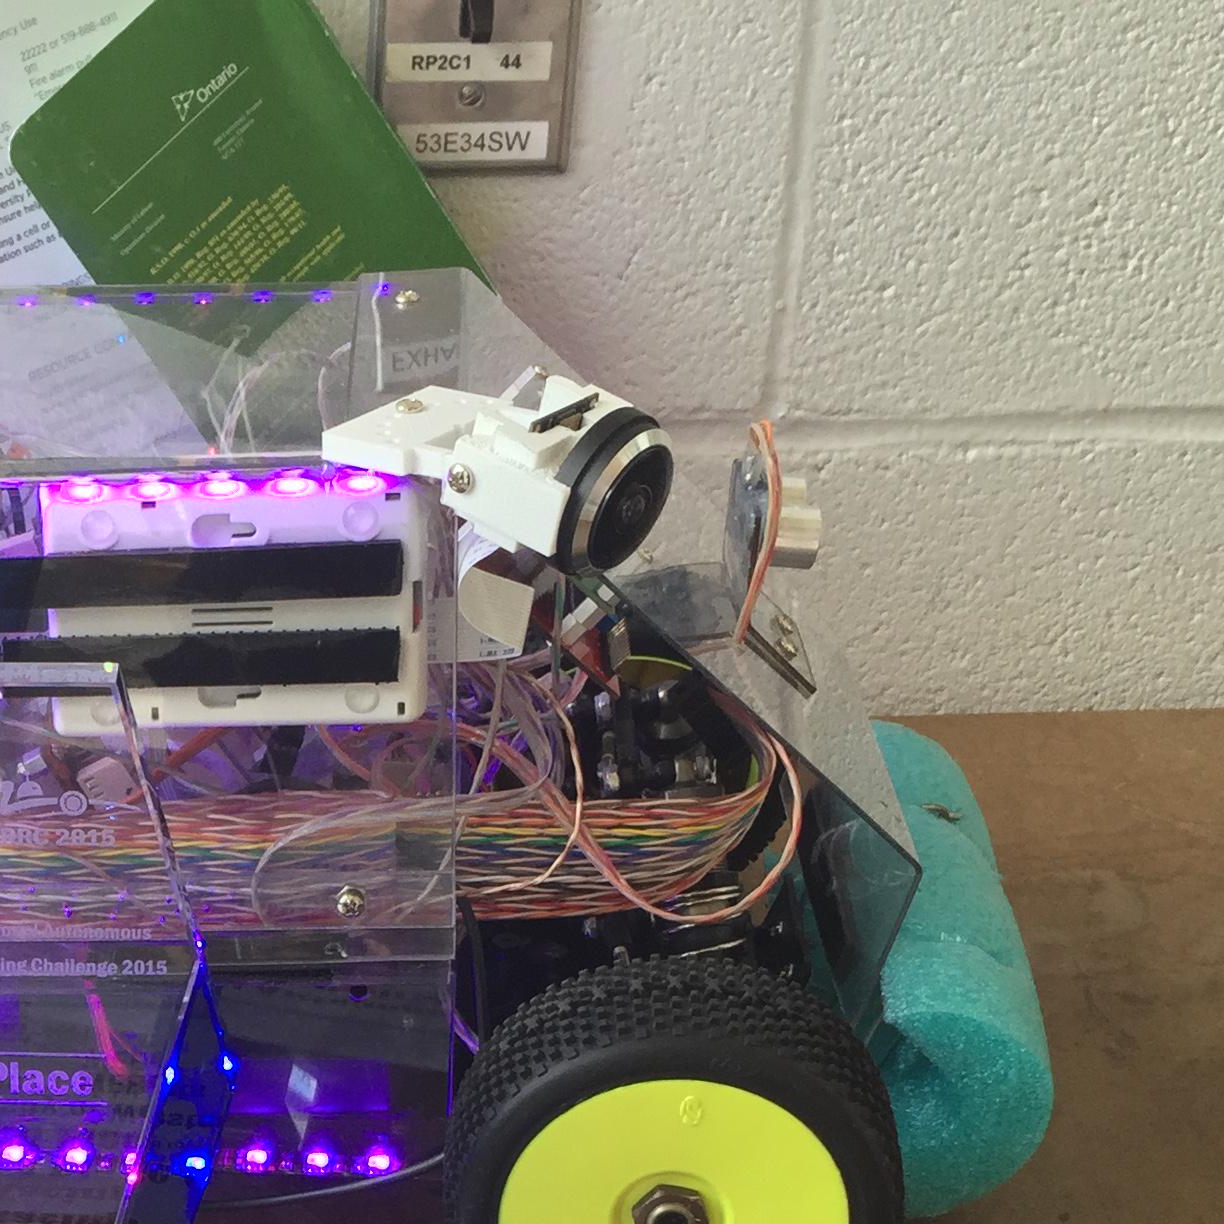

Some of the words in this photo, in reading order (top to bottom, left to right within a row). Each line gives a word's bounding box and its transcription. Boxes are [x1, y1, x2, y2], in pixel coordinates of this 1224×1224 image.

[19, 16, 39, 32] Use
[411, 54, 471, 71] RP2C1
[499, 53, 522, 70] 44
[28, 75, 49, 89] Fire
[49, 63, 75, 82] alarm
[196, 62, 238, 103] Ontario
[415, 131, 532, 154] 53E34SW
[23, 224, 40, 239] cell
[40, 220, 52, 231] or
[23, 238, 45, 254] such
[45, 233, 57, 244] as
[30, 957, 118, 978] Challenge
[121, 960, 168, 976] 2015
